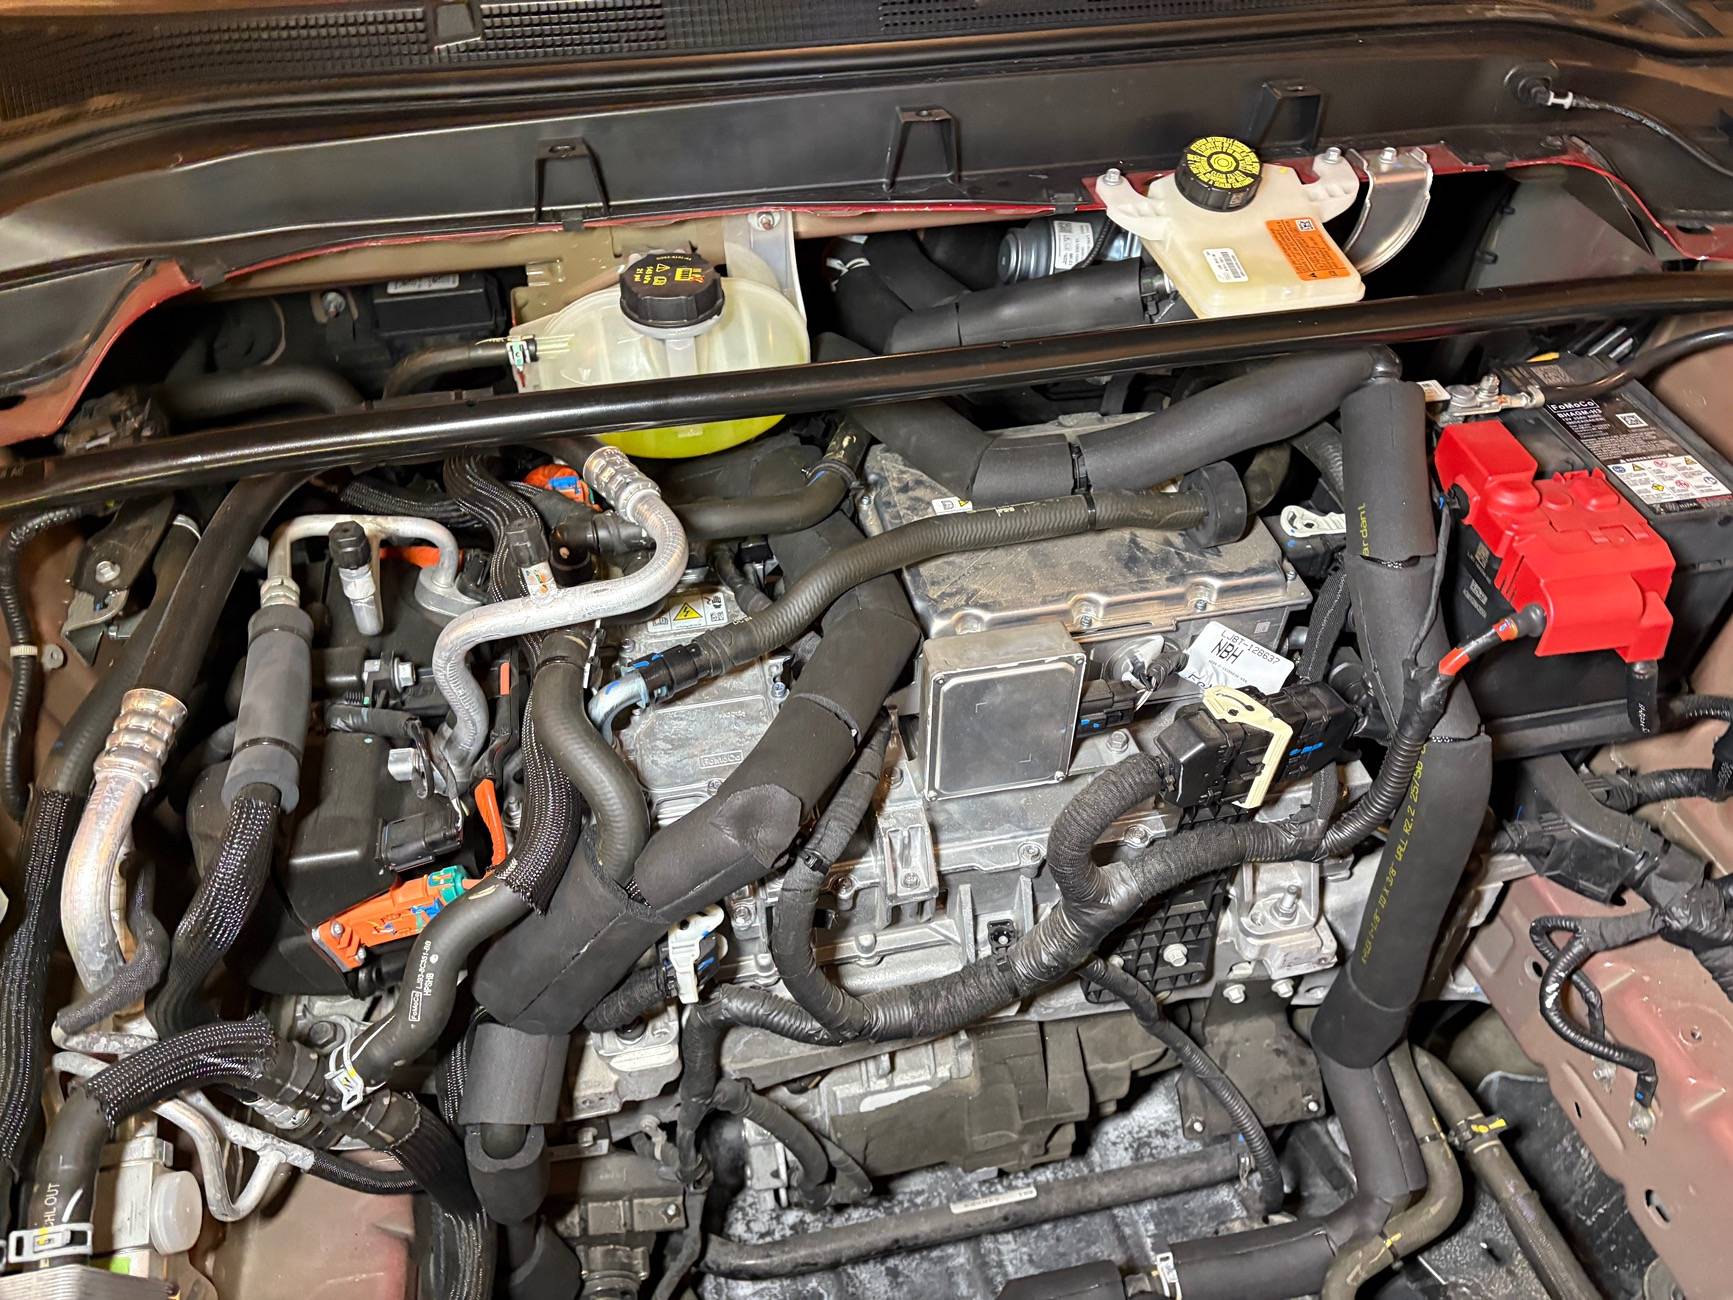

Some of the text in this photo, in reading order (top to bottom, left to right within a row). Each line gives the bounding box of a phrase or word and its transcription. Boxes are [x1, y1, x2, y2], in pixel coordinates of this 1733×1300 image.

[1551, 401, 1594, 410] FoMoCo
[1211, 639, 1243, 664] NBH
[411, 992, 420, 1019] FoMoCo
[44, 1183, 60, 1206] OUT
